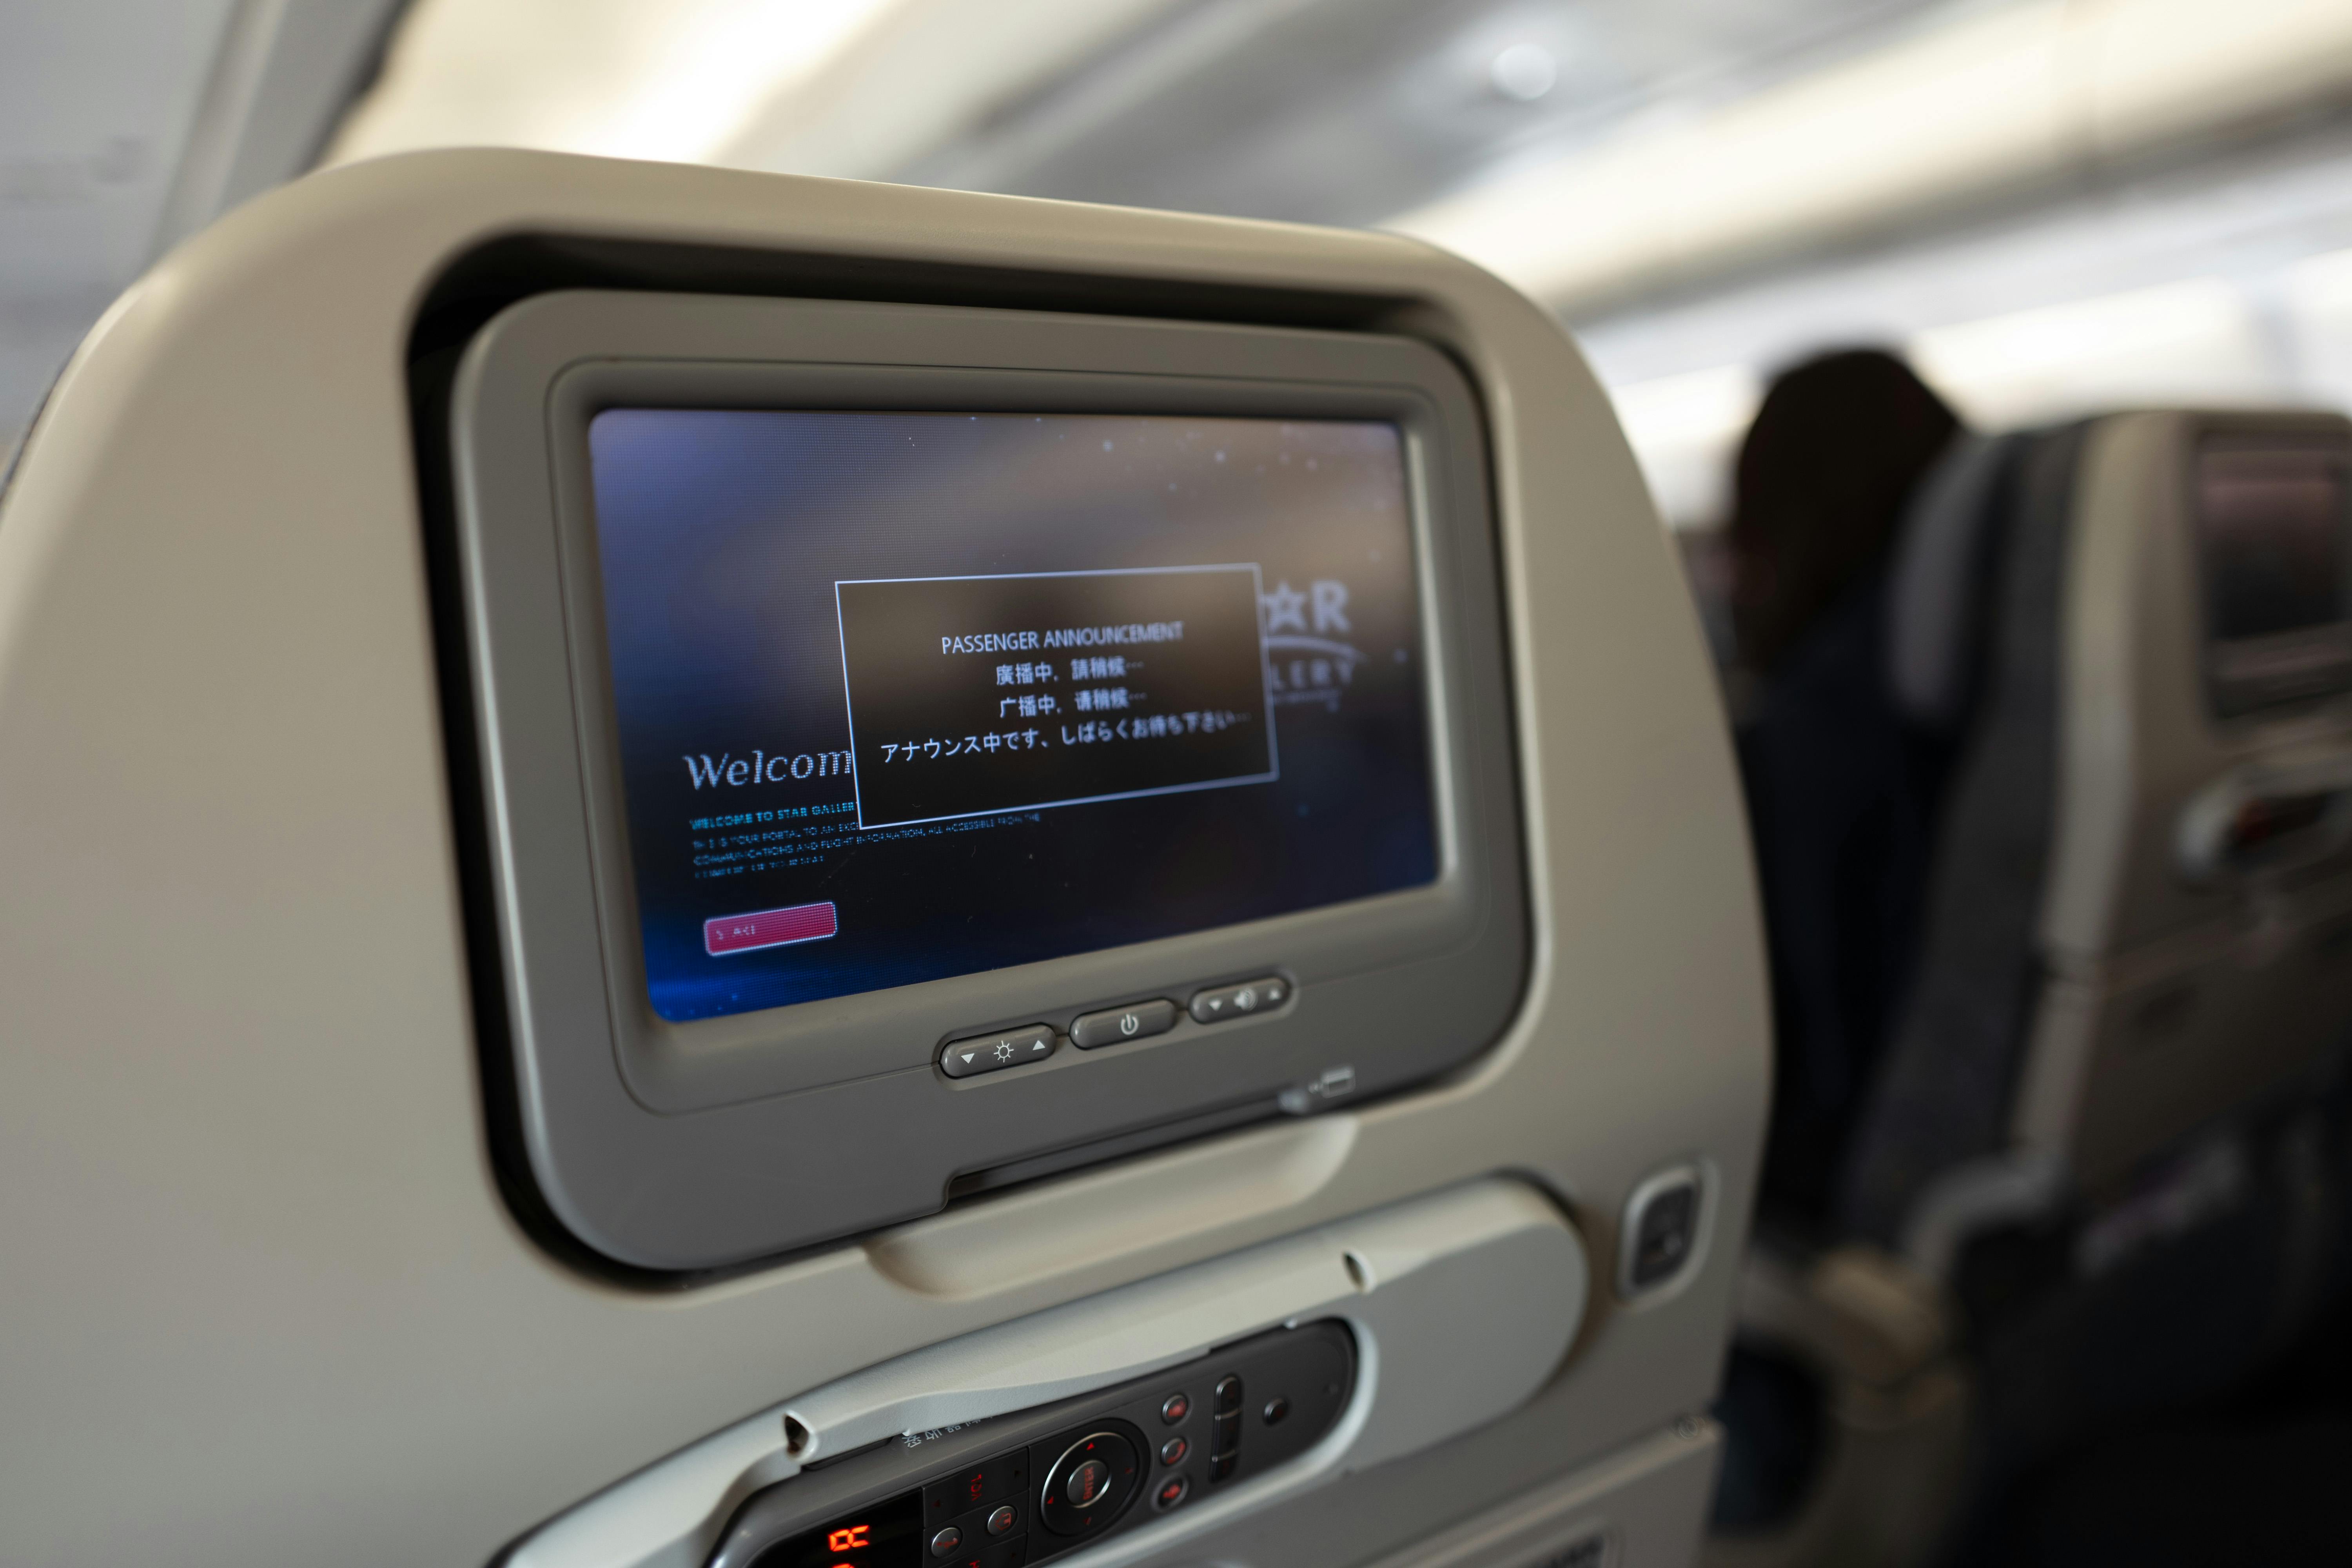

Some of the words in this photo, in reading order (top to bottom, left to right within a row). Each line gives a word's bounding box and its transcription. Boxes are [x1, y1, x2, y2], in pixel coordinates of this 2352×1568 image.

[942, 631, 1040, 654] PASSENGER
[1043, 621, 1183, 648] ANNOUNCEMENT
[690, 813, 753, 830] WELCOME
[755, 811, 773, 822] TO
[777, 807, 808, 820] STAR
[811, 802, 858, 815] GALLER
[971, 1474, 982, 1501] VOL
